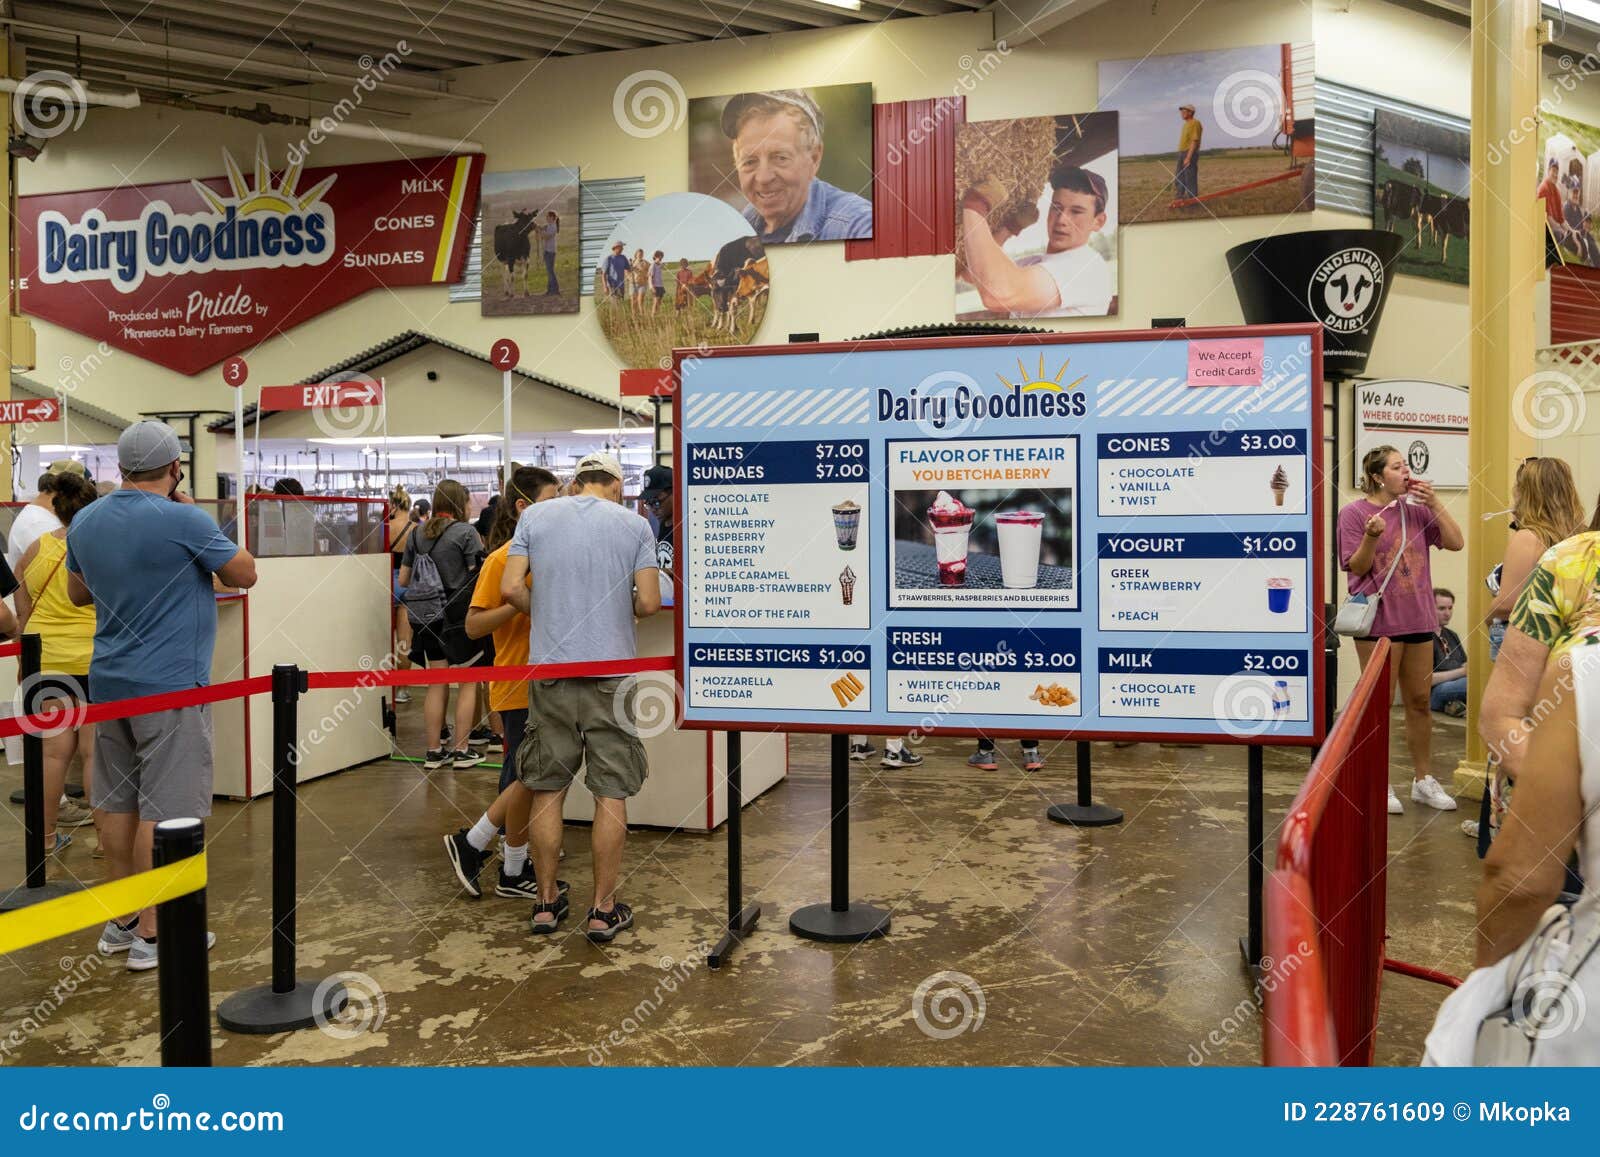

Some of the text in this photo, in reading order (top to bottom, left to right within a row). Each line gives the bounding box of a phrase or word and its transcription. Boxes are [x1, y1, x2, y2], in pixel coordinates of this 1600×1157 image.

[402, 178, 444, 195] MILK
[375, 215, 435, 231] CONES
[45, 206, 326, 282] Dairy Goodness
[344, 251, 425, 268] SUNDAES
[1316, 251, 1382, 284] UNDENIABLY
[108, 284, 268, 323] Produced with Pride by
[1325, 313, 1364, 330] DAIRY
[124, 323, 253, 339] Minnesota Dairy Farmers
[499, 346, 511, 363] 2
[1198, 351, 1251, 362] We Accept
[230, 365, 240, 379] 3
[1195, 366, 1256, 377] Credit Cards
[303, 386, 341, 406] EXIT
[1362, 391, 1405, 407] We Are
[877, 384, 1087, 429] Dairy Goodness
[1363, 410, 1469, 424] WHERE GOOD COMES FROM
[1107, 434, 1296, 453] CONES $3.00
[692, 444, 863, 460] MALTS $7.00
[900, 447, 1065, 464] FLAVOR OF THE FAIR
[692, 464, 864, 480] SUNDAES $7.00
[912, 468, 1051, 482] YOU BETCHA BERRY
[1119, 467, 1195, 479] CHOCOLATE
[1119, 481, 1171, 492] VANILLA
[704, 493, 769, 504] CHOCOLATE
[1119, 496, 1157, 506] TWIST
[704, 507, 749, 516] VANILLA
[704, 519, 775, 529] STRAWBERRY
[704, 532, 765, 542] RASPBERRY
[704, 545, 765, 555] BLUEBERRY
[1108, 537, 1296, 553] YOGURT $1.00
[704, 558, 755, 567] CARAMEL
[704, 570, 790, 580] APPLE CARAMEL
[1111, 568, 1150, 579] GREEK
[705, 583, 832, 593] RHUBARB-STRAWBERRY
[1120, 581, 1201, 592] STRAWBERRY
[705, 596, 732, 606] MINT
[898, 594, 1070, 602] STRAWBERRIES, RASPBERRIES AND BLUEBERRIES
[705, 609, 810, 619] FLAVOR OF THE FAIR
[1118, 611, 1159, 621] PEACH
[892, 631, 942, 645] FRESH
[694, 648, 865, 664] CHEESE STICKS $1.00
[892, 652, 1076, 667] CHEESE CURDS $3.00
[1108, 653, 1299, 671] MILK $2.00
[702, 676, 773, 687] MOZZARELLA
[907, 680, 1001, 691] WHITE CHEDDAR
[702, 689, 753, 699] CHEDDAR
[1120, 684, 1196, 694] CHOCOLATE
[907, 693, 949, 703] GARLIC
[1120, 697, 1161, 707] WHITE
